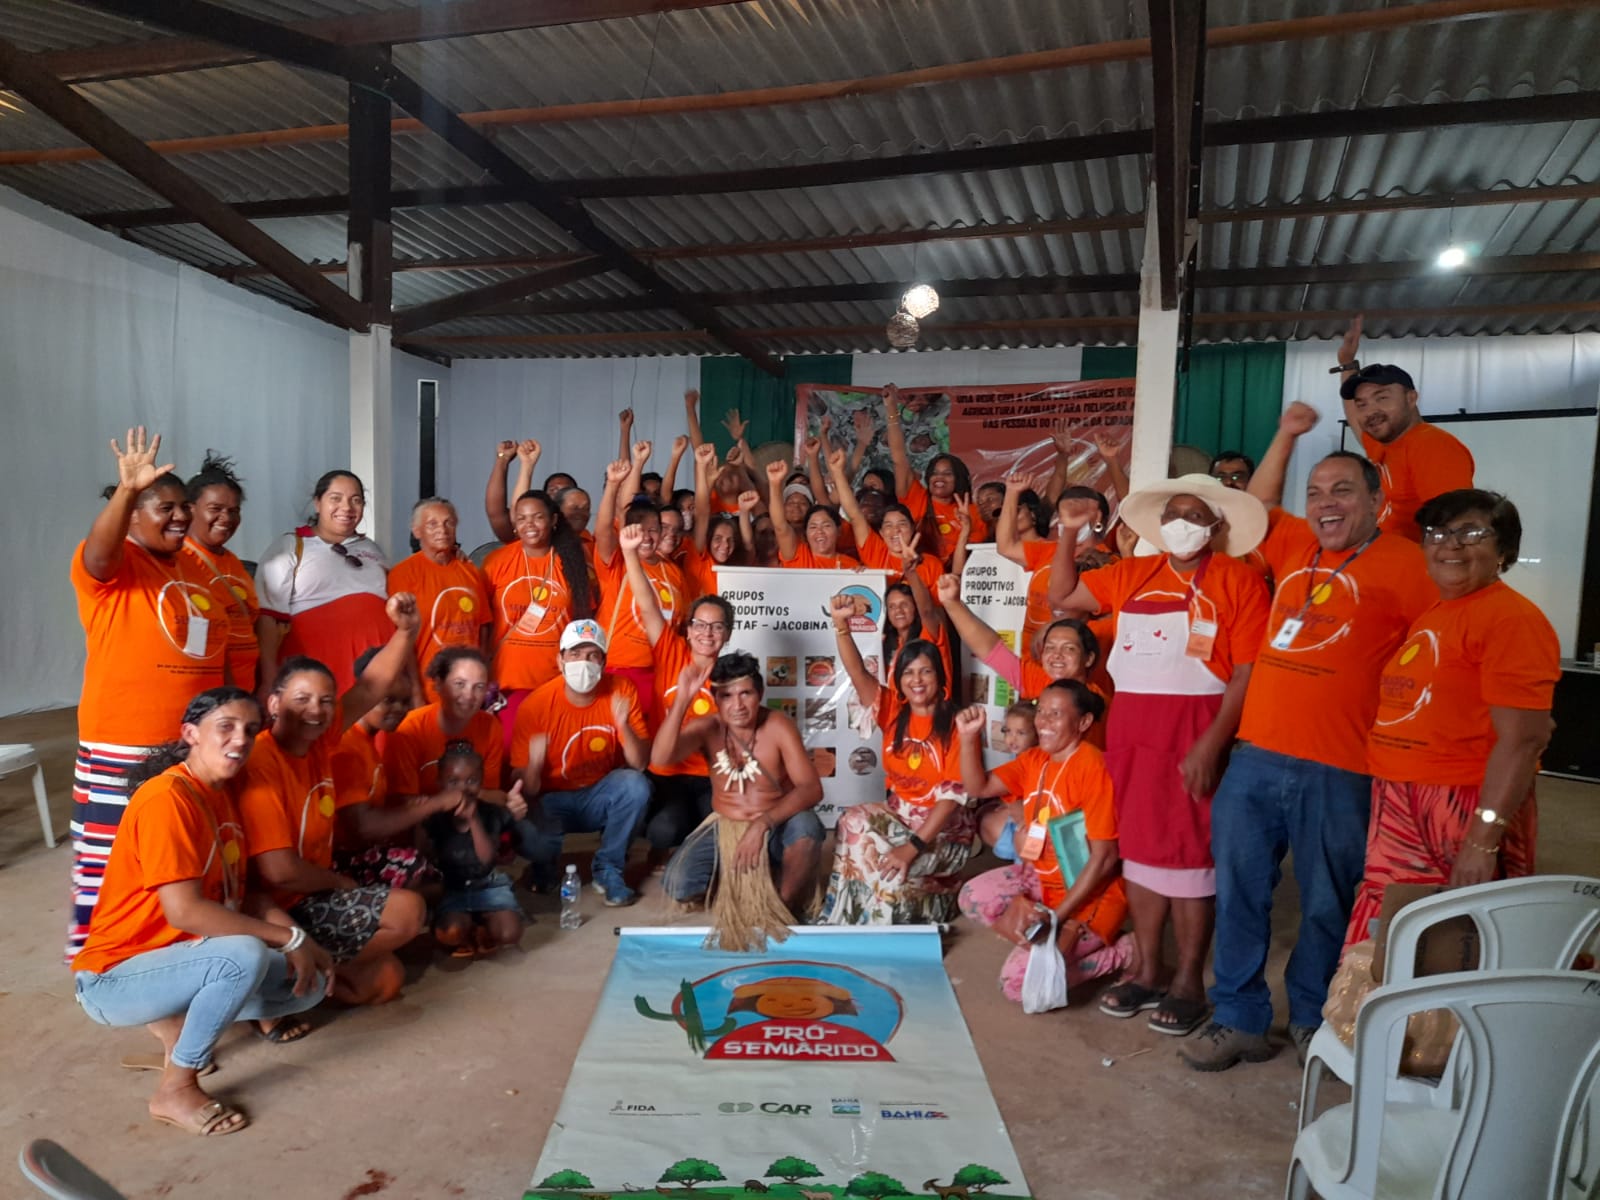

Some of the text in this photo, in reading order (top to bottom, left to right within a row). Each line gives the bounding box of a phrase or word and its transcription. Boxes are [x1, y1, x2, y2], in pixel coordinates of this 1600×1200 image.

[962, 406, 1015, 416] AGRICULTURA
[1017, 404, 1056, 415] FAMILIAR
[1001, 418, 1037, 428] PESSOAS
[966, 566, 997, 577] GRUPOS
[965, 581, 1014, 591] PRODUTIVOS
[722, 590, 764, 601] GRUPOS
[965, 595, 993, 605] SETAF
[731, 605, 790, 616] RODUTIVOS
[773, 620, 828, 631] JACOBINA
[762, 1024, 838, 1041] PRÓ-
[724, 1040, 878, 1057] SEMIÁRIDO
[627, 1104, 656, 1112] FIDA
[760, 1102, 812, 1115] CAR
[880, 1110, 938, 1119] BAHIA
